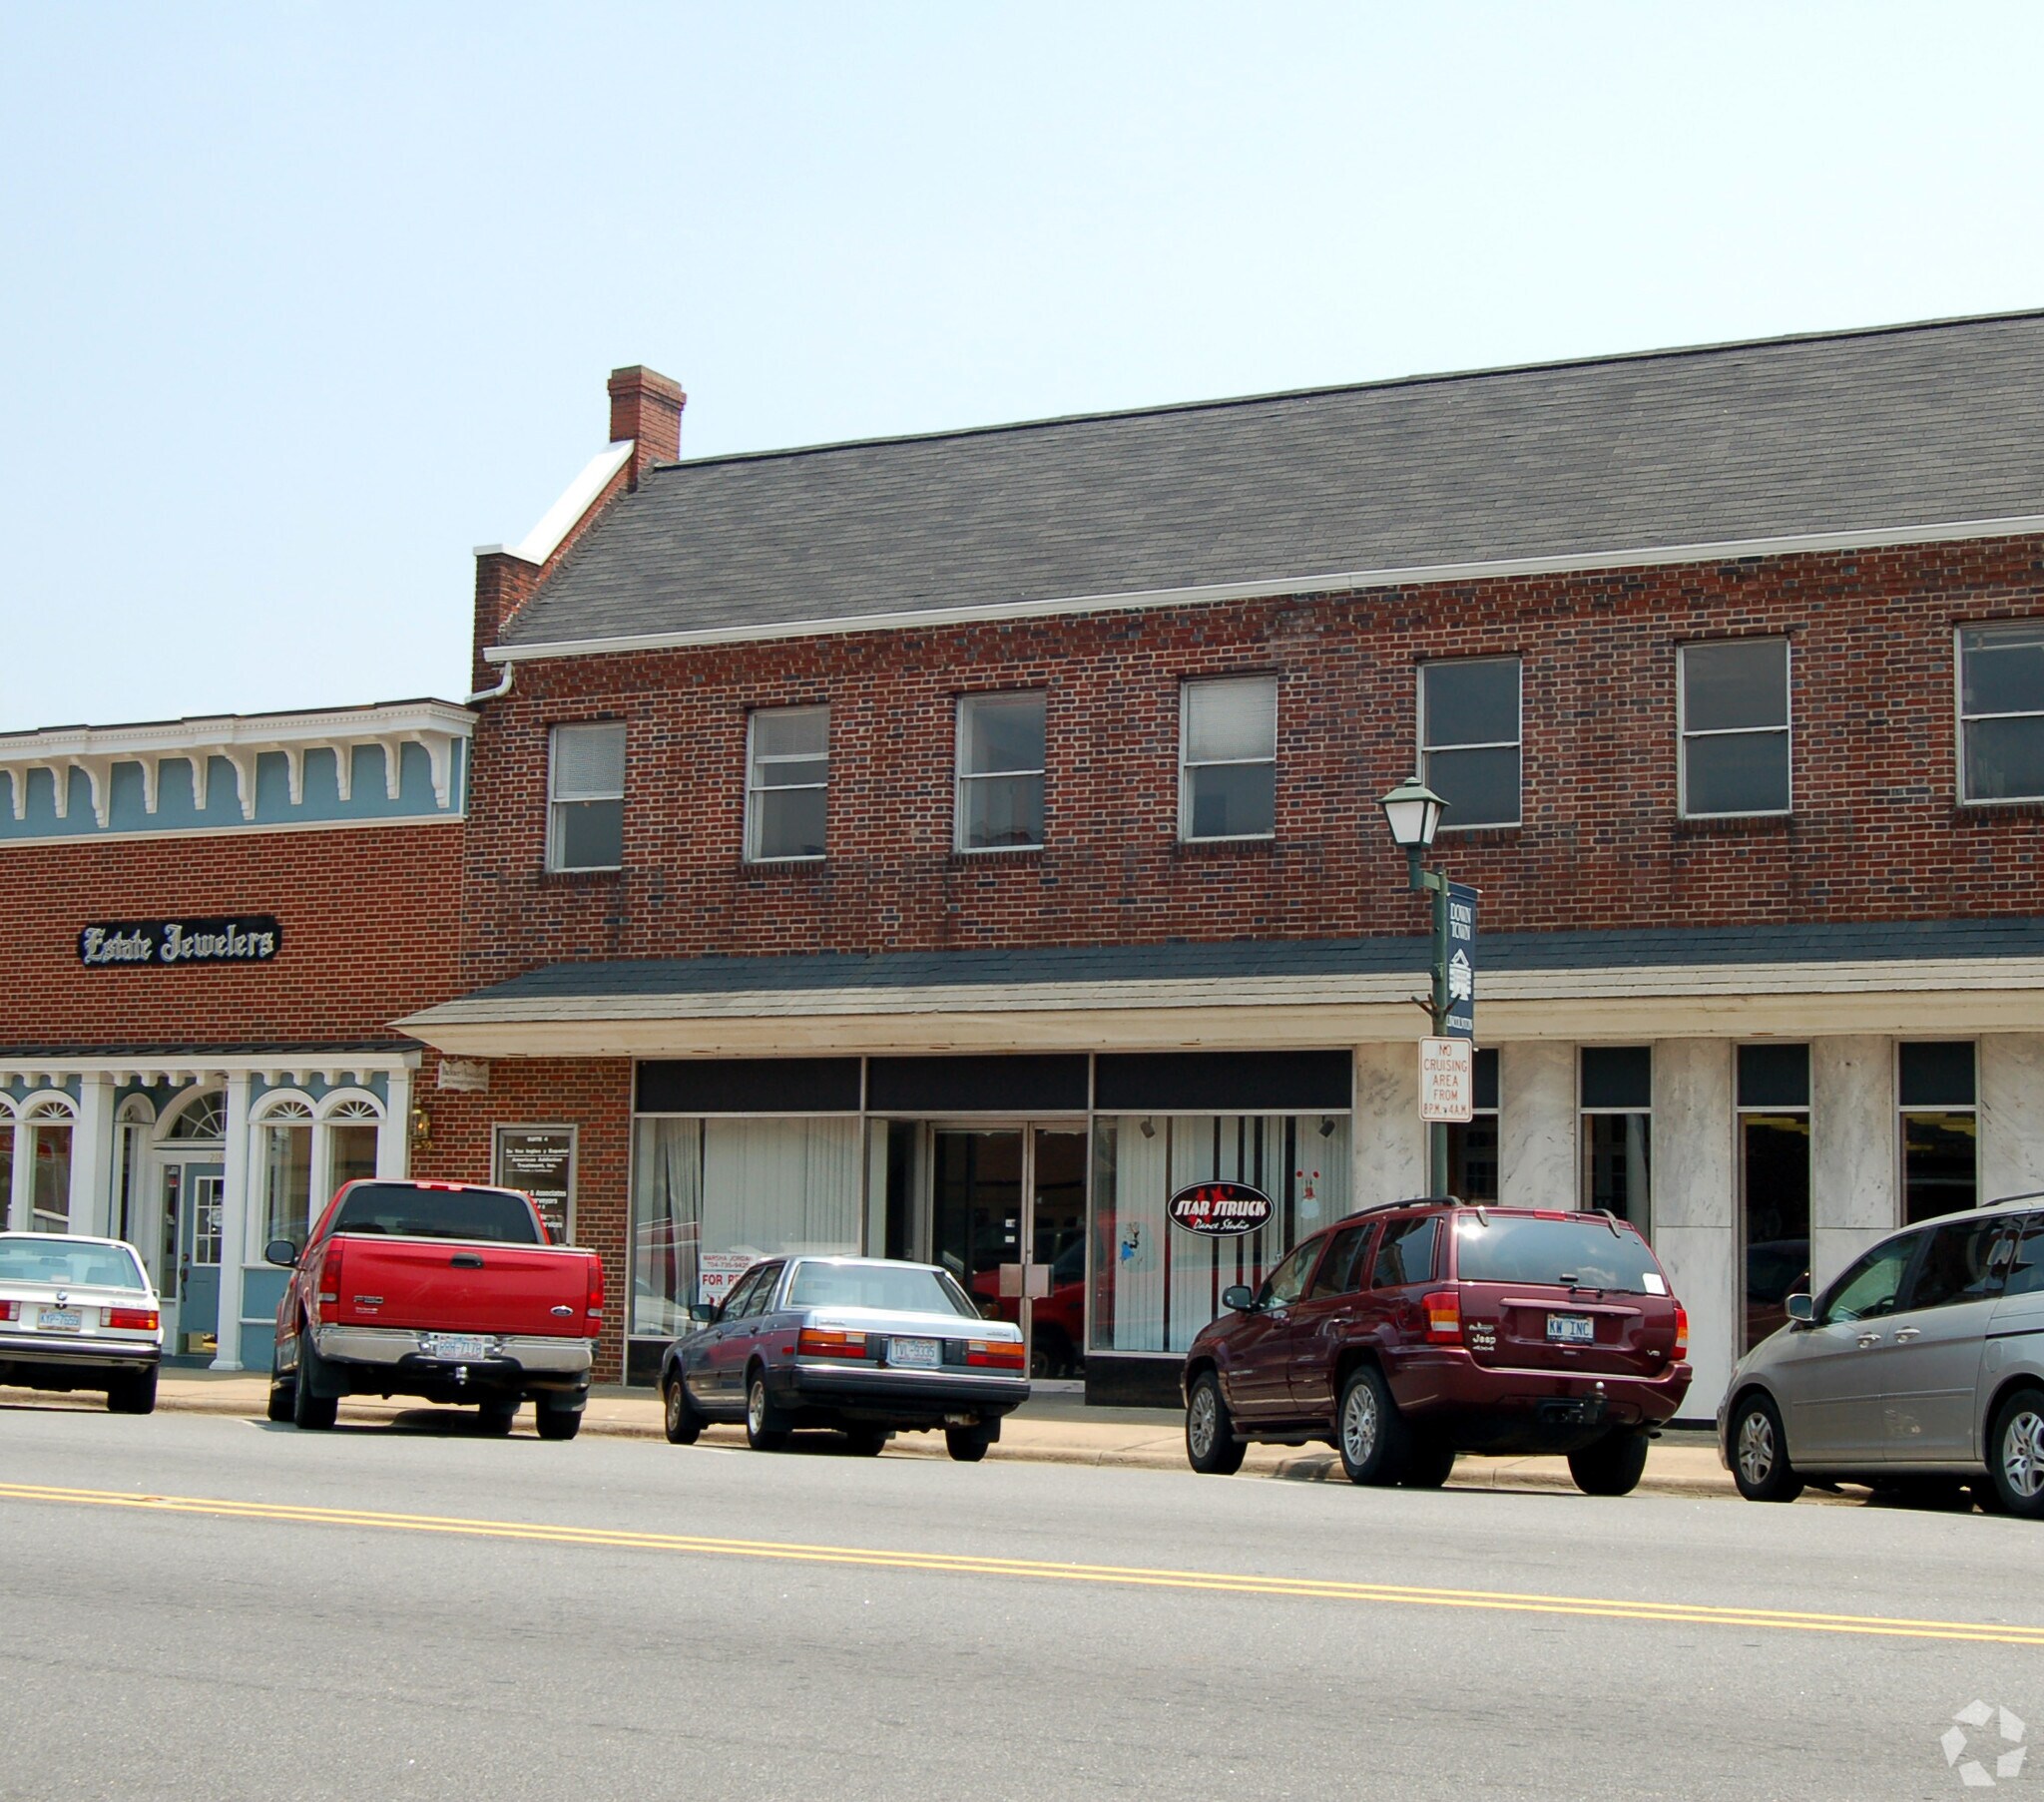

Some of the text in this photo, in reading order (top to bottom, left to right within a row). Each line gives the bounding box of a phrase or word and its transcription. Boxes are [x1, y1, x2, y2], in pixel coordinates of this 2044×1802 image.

[84, 923, 274, 965] Estate Jewelers
[1438, 1044, 1452, 1057] NO
[1423, 1058, 1468, 1073] CRUISING
[1432, 1074, 1458, 1088] AREA
[1433, 1089, 1458, 1102] FROM
[1175, 1200, 1267, 1216] STAR STRUCK
[1220, 1218, 1251, 1230] Studio
[702, 1274, 724, 1286] FOR
[1549, 1319, 1590, 1336] KW INC
[1472, 1333, 1496, 1345] Jeep
